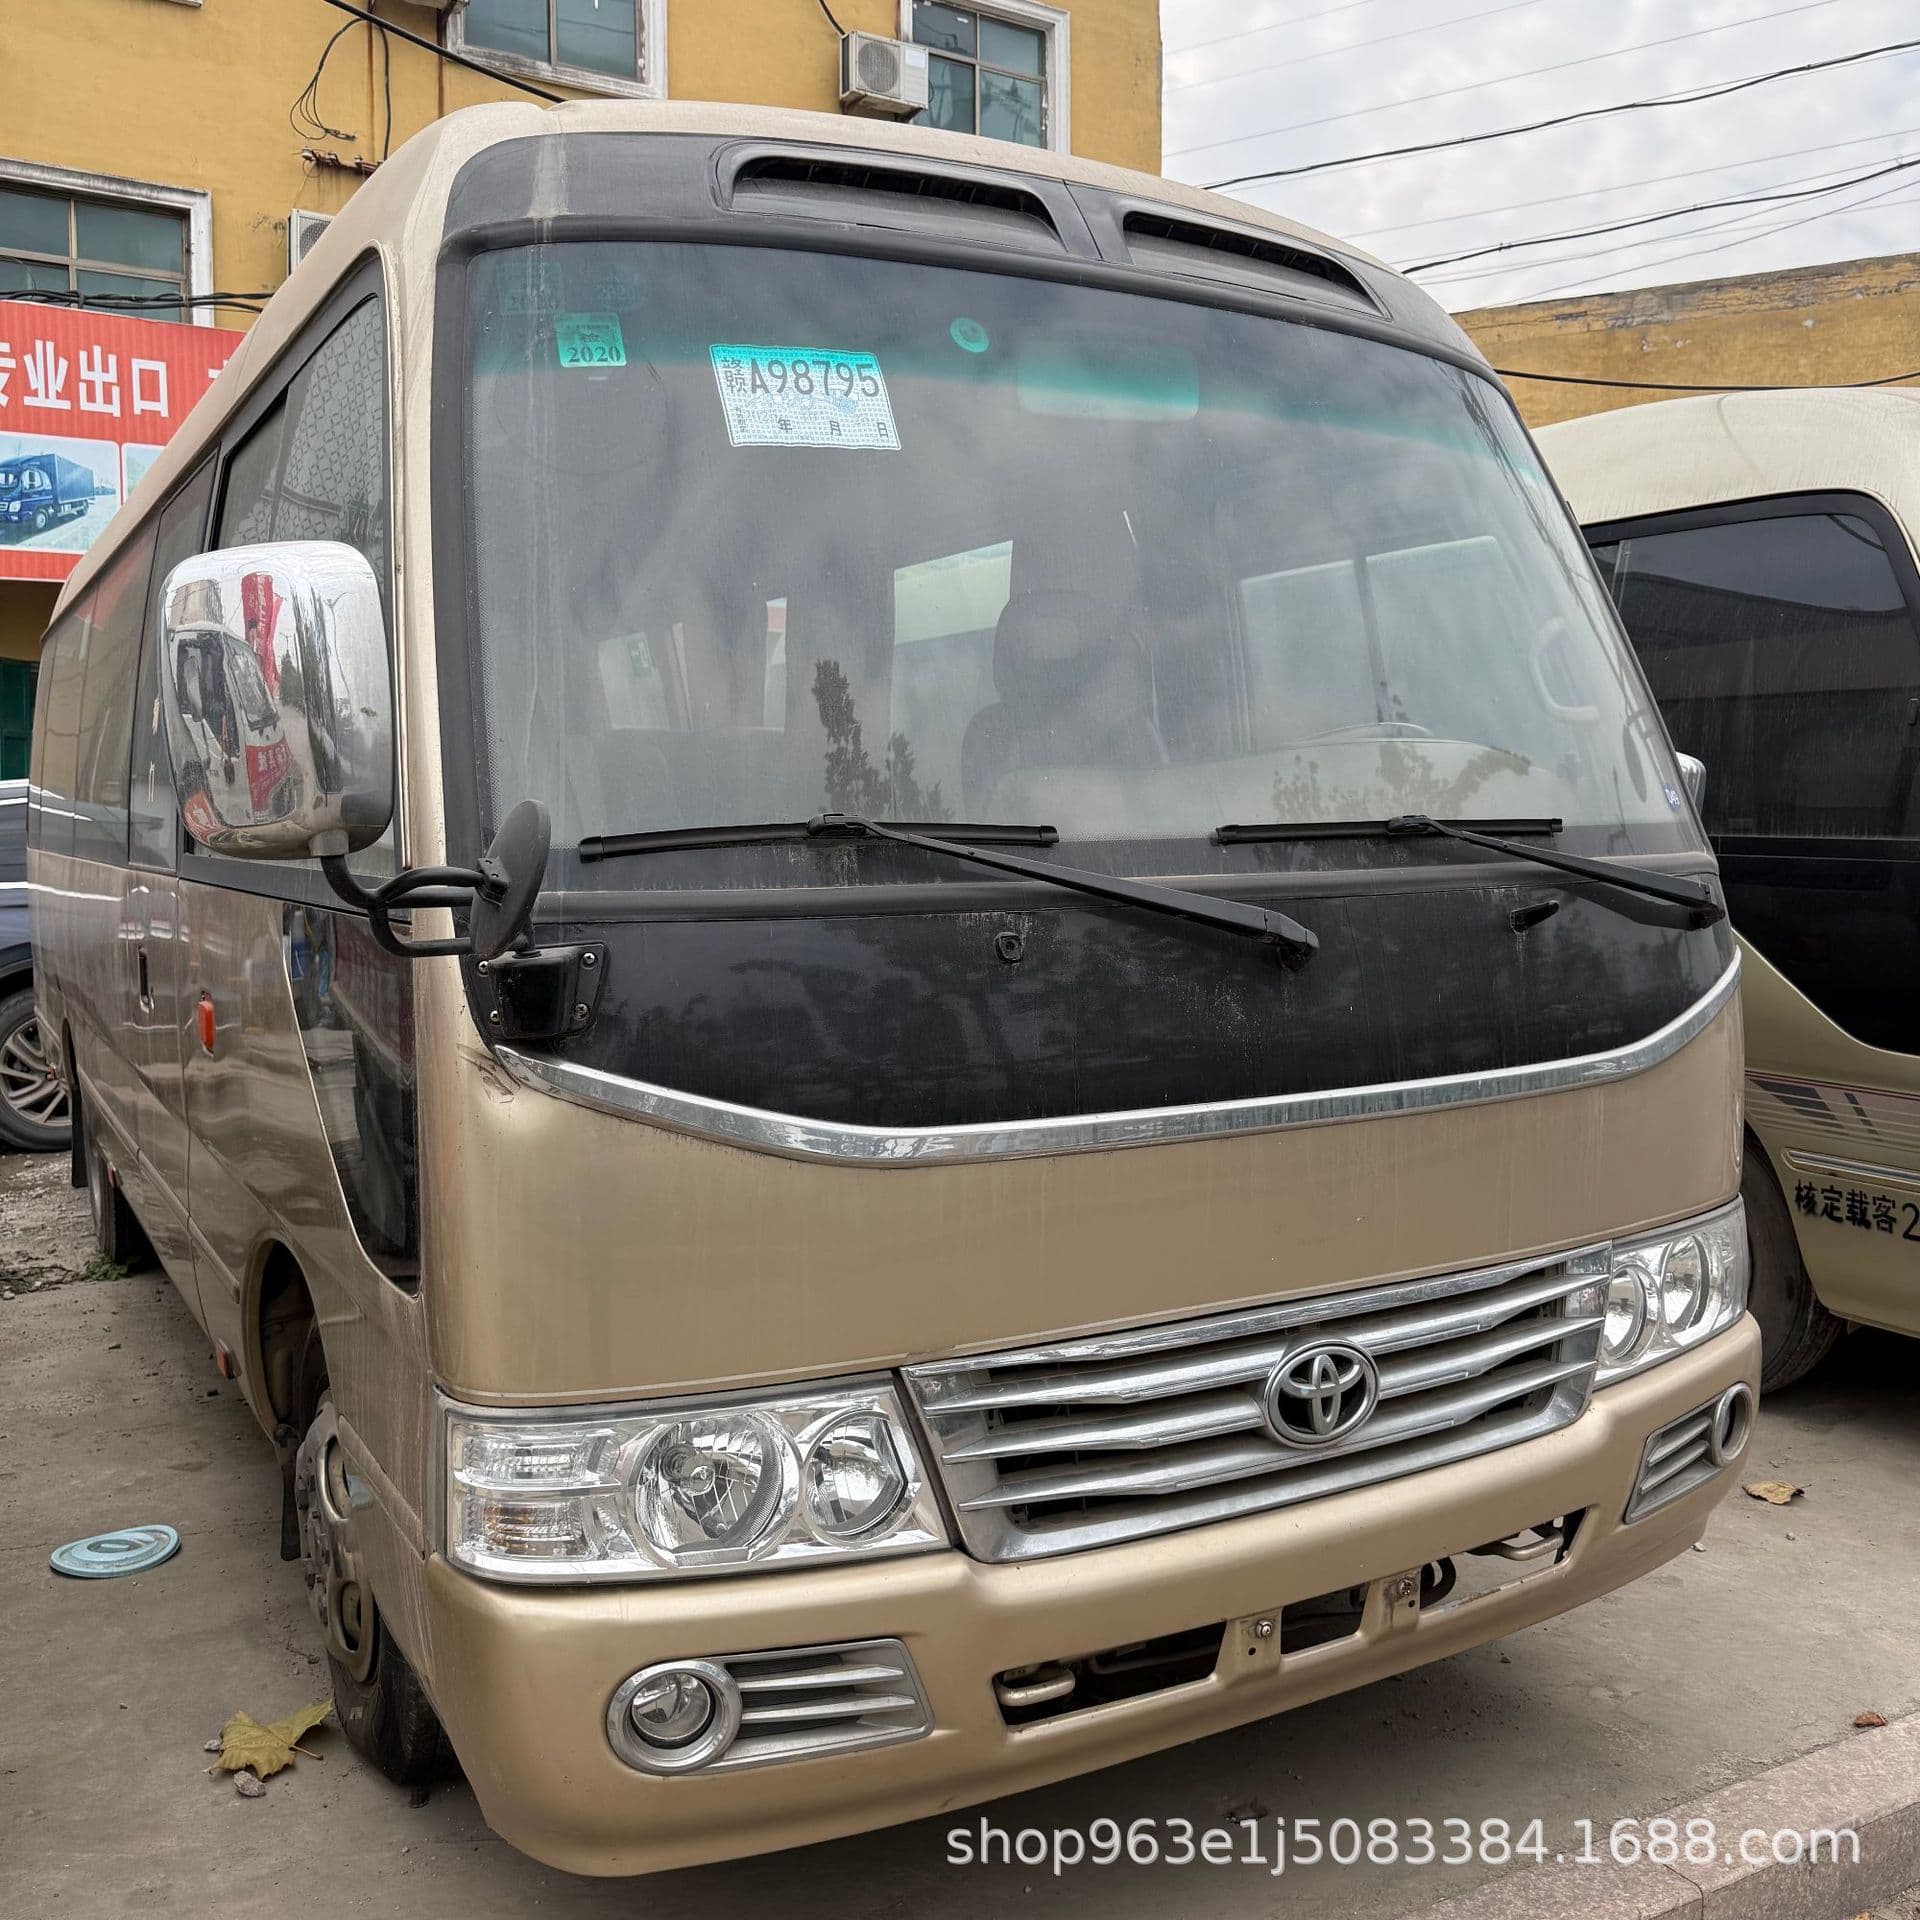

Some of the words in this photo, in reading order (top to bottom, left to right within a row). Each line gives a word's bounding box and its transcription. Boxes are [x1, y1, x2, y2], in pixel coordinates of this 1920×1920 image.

[567, 345, 621, 364] 2020
[778, 419, 793, 434] 年
[830, 420, 842, 437] 月
[878, 422, 889, 438] 日
